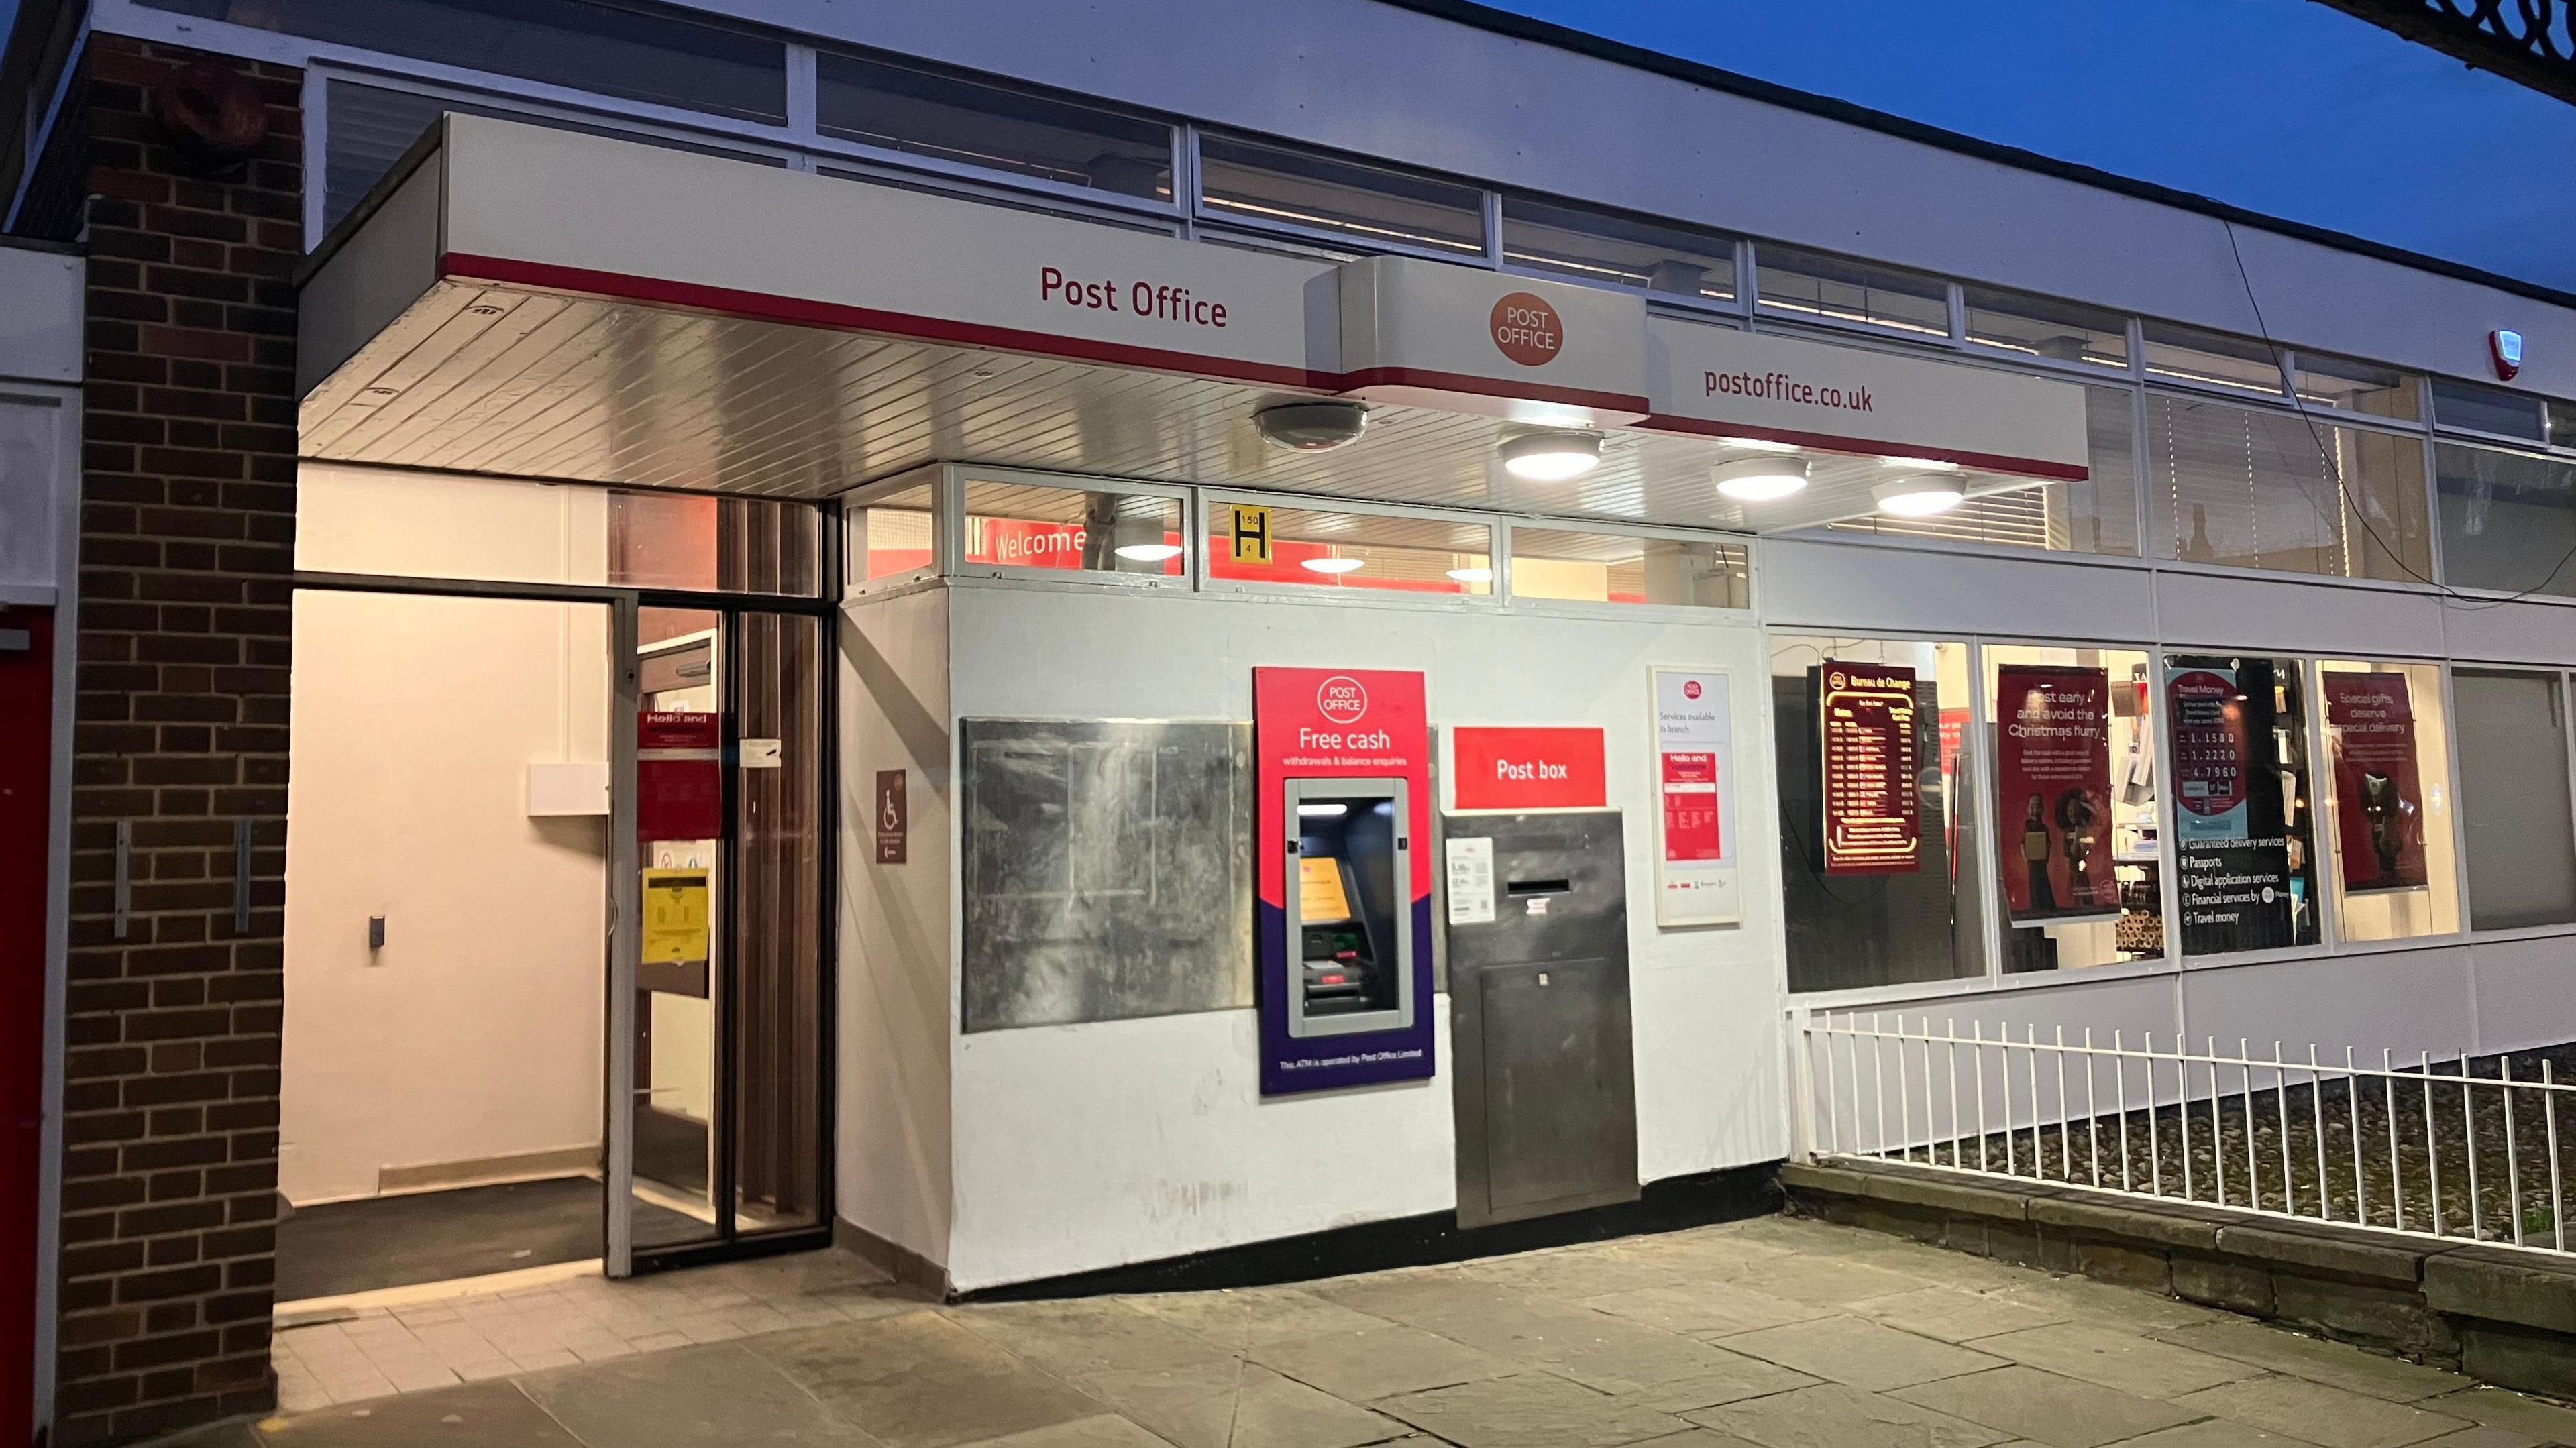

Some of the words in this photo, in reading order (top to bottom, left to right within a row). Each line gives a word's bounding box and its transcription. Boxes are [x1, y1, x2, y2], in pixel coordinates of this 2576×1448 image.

[1041, 266, 1118, 311] Post
[1132, 280, 1227, 327] Office
[1507, 307, 1549, 329] POST
[1497, 326, 1556, 349] OFFICE
[1704, 370, 1873, 412] postoffice.co.uk
[1242, 516, 1259, 525] 150
[1234, 510, 1266, 558] H
[996, 530, 1087, 562] Welcome
[1246, 545, 1251, 553] 4
[1851, 675, 1876, 687] Bureau
[1876, 677, 1885, 687] de
[1886, 677, 1911, 690] Change
[1329, 687, 1356, 698] POST
[2178, 684, 2198, 693] Travel
[2199, 685, 2224, 696] Money
[2059, 691, 2084, 705] early
[2340, 692, 2371, 705] Special
[2371, 693, 2394, 706] gifts
[1323, 700, 1361, 711] OFFICE
[647, 714, 681, 724] Hello
[684, 714, 707, 724] and
[1659, 711, 1686, 720] Services
[1688, 711, 1715, 721] available
[2017, 709, 2040, 720] and
[2042, 708, 2074, 720] avoid
[2076, 708, 2094, 720] the
[2351, 708, 2387, 718] deserve
[1660, 725, 1666, 733] in
[1667, 724, 1690, 733] branch
[2008, 724, 2072, 737] Christmas
[2074, 725, 2101, 739] flurry
[2368, 722, 2406, 734] delivery
[1299, 728, 1342, 750] Free
[1346, 728, 1391, 750] cash
[2190, 732, 2235, 743] 1.1580
[1282, 756, 1332, 766] withdrawals
[1333, 755, 1340, 766] &
[1341, 756, 1371, 766] balance
[1373, 757, 1407, 767] enquiries
[1670, 754, 1690, 762] Hello
[1691, 754, 1707, 762] and
[2192, 750, 2235, 761] 1.2220
[1497, 759, 1534, 780] Post
[1538, 759, 1568, 779] box
[2188, 838, 2229, 850] Guaranteed
[2229, 838, 2258, 850] delivery
[2258, 836, 2285, 847] services
[2190, 856, 2222, 871] Passports
[2191, 873, 2214, 890] Digital
[2214, 872, 2251, 889] application
[2252, 872, 2279, 883] services
[2192, 891, 2222, 905] Financial
[2222, 893, 2250, 903] services
[2250, 889, 2260, 905] by
[2193, 910, 2214, 924] Travel
[2215, 913, 2239, 925] money
[1279, 1061, 1295, 1069] This
[1296, 1059, 1312, 1068] ATM
[1361, 1053, 1376, 1062] Post
[1377, 1051, 1397, 1060] Office
[1397, 1049, 1423, 1058] Limited
